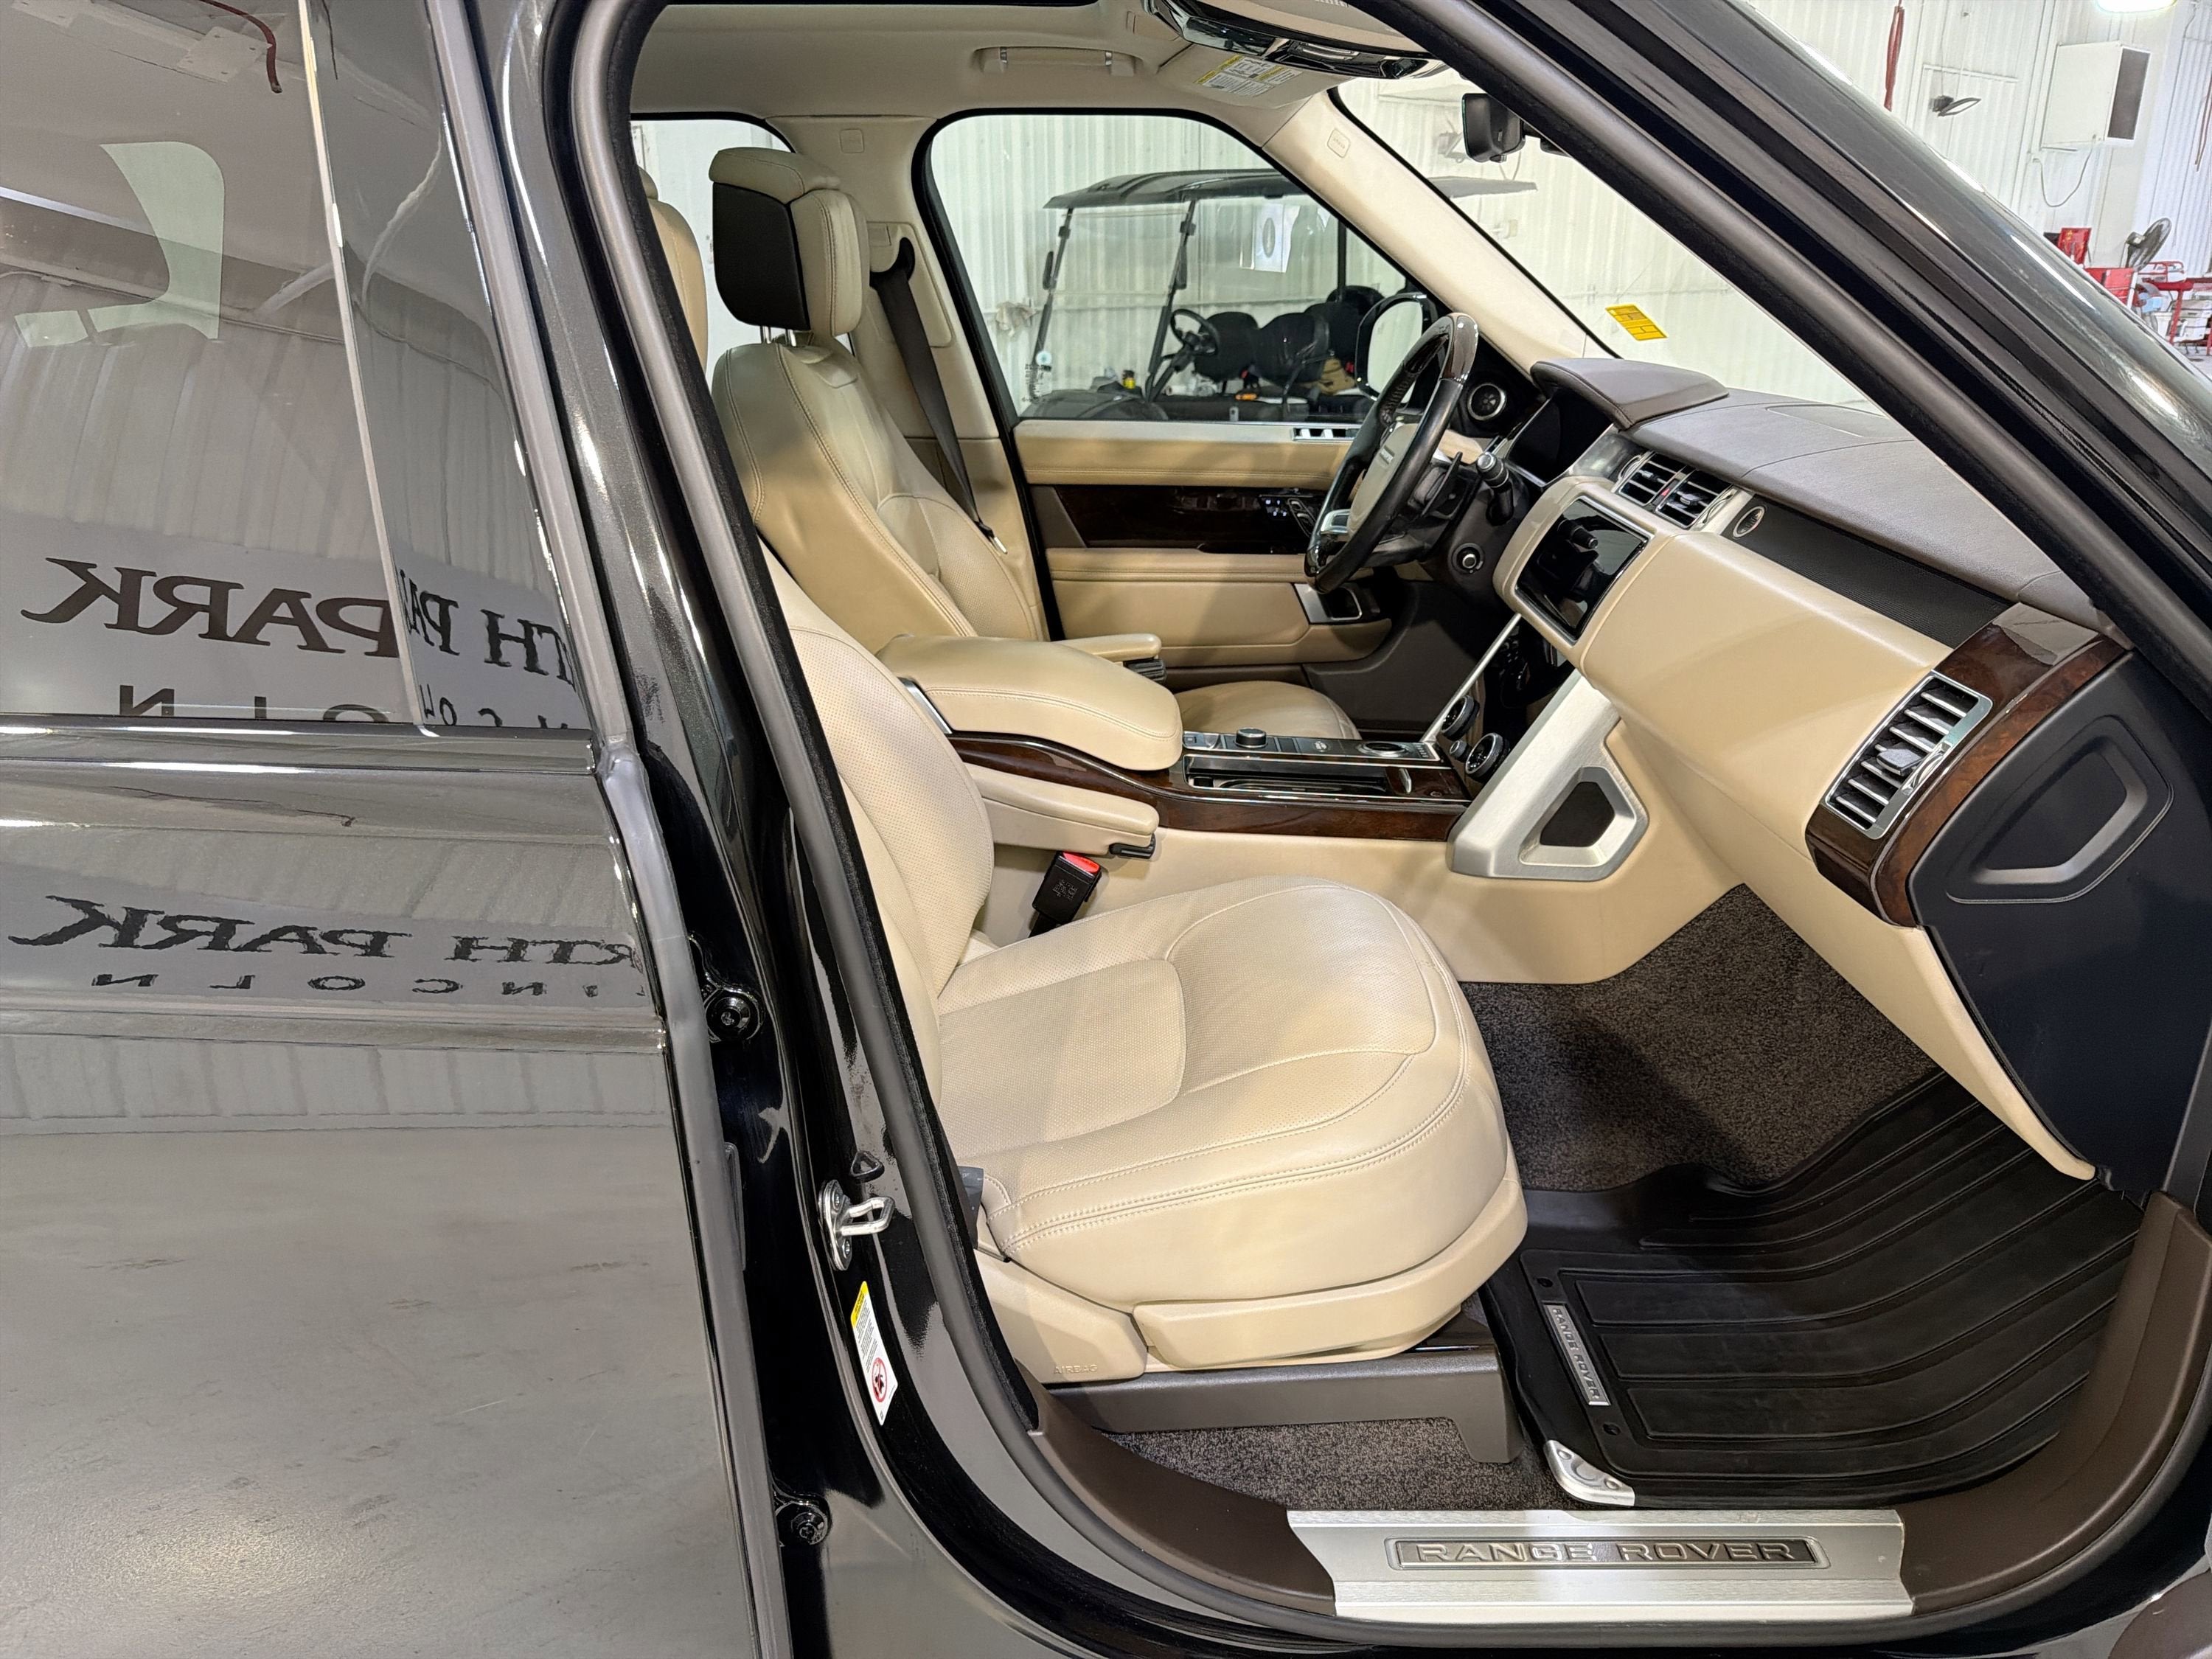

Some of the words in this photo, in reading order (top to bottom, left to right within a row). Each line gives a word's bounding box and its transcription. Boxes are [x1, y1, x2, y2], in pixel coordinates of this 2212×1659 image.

[1552, 1308, 1579, 1350] RANGE
[1573, 1354, 1600, 1399] ROVER
[1054, 1364, 1098, 1375] AIRBAG
[1416, 1543, 1597, 1562] RANGE
[1617, 1543, 1795, 1562] ROVER
